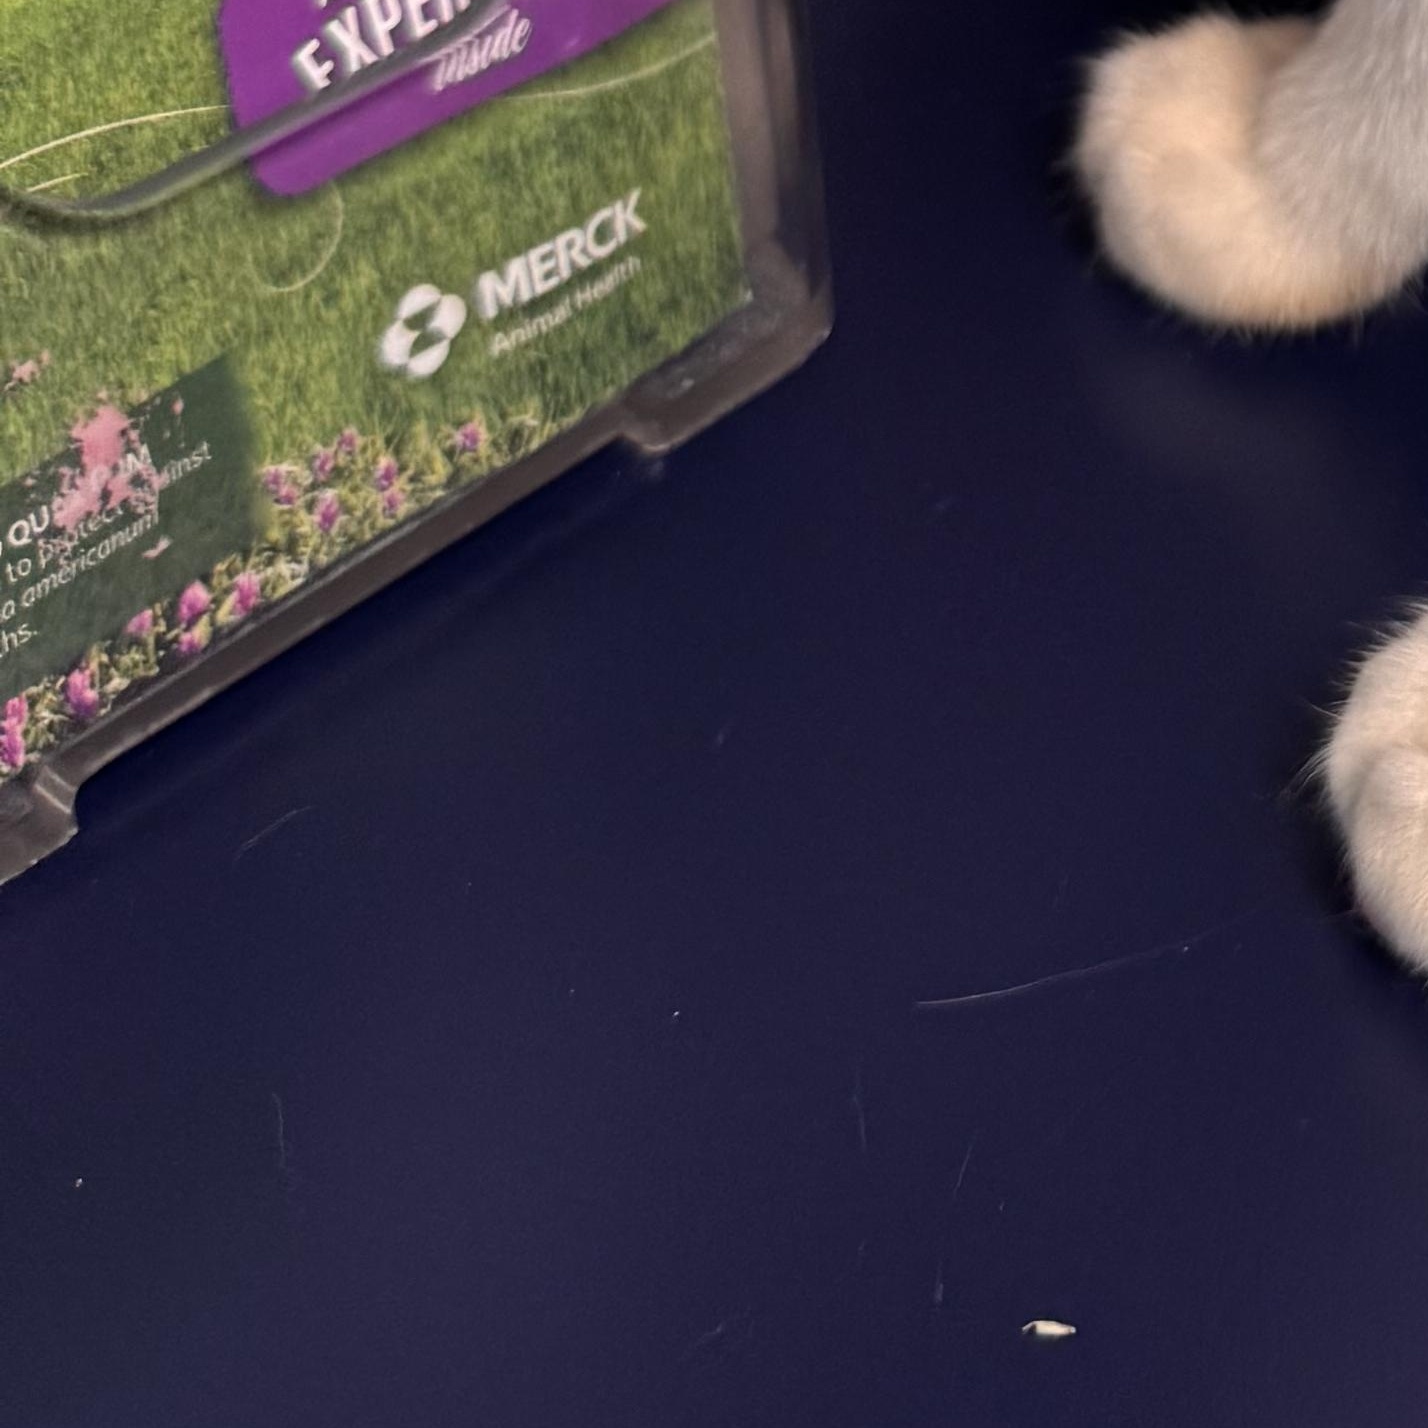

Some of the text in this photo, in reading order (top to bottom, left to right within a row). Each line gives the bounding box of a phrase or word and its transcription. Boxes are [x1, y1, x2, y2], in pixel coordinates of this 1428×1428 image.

[477, 188, 648, 321] MERCK
[489, 297, 572, 357] Animal
[6, 556, 32, 583] to
